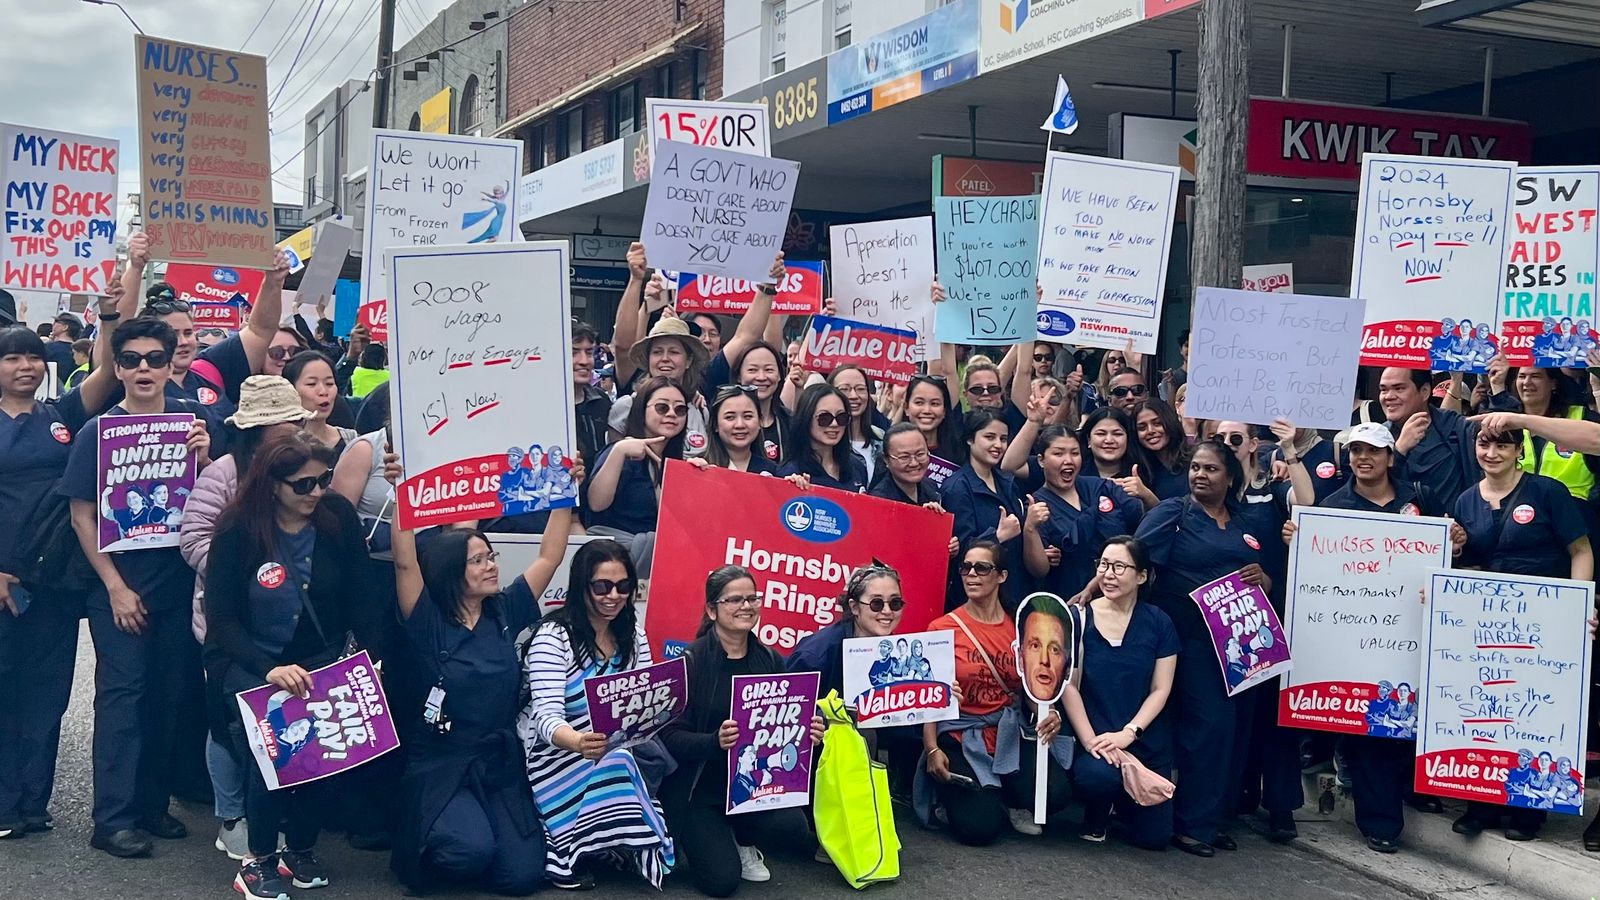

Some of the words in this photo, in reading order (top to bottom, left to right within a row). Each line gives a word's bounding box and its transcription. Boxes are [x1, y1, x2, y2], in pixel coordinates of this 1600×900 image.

[882, 26, 928, 59] WISDOM
[996, 47, 1022, 63] Selective
[1023, 37, 1045, 53] School,
[1047, 31, 1062, 45] HSC
[1063, 20, 1095, 38] Coaching
[153, 82, 191, 109] very
[774, 77, 818, 130] 8385
[153, 109, 187, 132] very
[659, 112, 718, 146] 15%
[721, 114, 756, 147] OR
[151, 132, 184, 153] very
[381, 141, 413, 165] We
[1283, 119, 1397, 163] KWIK
[13, 133, 58, 166] MY
[58, 143, 116, 175] NECK
[151, 153, 184, 177] very
[663, 152, 679, 178] A
[750, 167, 786, 191] WHO
[1380, 166, 1448, 190] 2024
[150, 178, 181, 199] very
[379, 169, 411, 192] Let
[422, 175, 436, 193] it
[442, 181, 464, 208] go
[961, 179, 991, 192] PATEL
[6, 181, 48, 210] MY
[52, 184, 113, 217] BACK
[374, 204, 406, 217] From
[717, 192, 746, 209] CARE
[751, 198, 788, 213] ABOUT
[1062, 187, 1083, 204] WE
[1088, 192, 1120, 208] HAVE
[1126, 195, 1159, 212] BEEN
[1378, 189, 1474, 215] Hornsby
[149, 200, 205, 223] CHRIS
[210, 205, 268, 228] MINNS
[409, 215, 449, 229] Frozen
[692, 206, 748, 227] NURSES
[950, 199, 989, 226] HEY
[1075, 211, 1103, 226] TOLD
[1380, 214, 1444, 231] Nurses
[1455, 208, 1493, 223] need
[5, 211, 45, 234] Fix
[47, 219, 87, 241] OUR
[88, 219, 117, 245] PAY
[167, 221, 206, 252] VERY
[390, 227, 405, 238] To
[413, 234, 437, 245] FAIR
[711, 229, 740, 245] CARE
[744, 233, 779, 249] ABOUT
[1055, 225, 1066, 235] TO
[1074, 229, 1100, 239] MAKE
[1109, 232, 1124, 241] NO
[1127, 236, 1157, 246] NOISE
[10, 236, 59, 257] THIS
[689, 243, 731, 263] YOU
[845, 228, 918, 263] Appreciation
[943, 232, 955, 252] If
[961, 237, 993, 256] you're
[1003, 238, 1028, 249] worth
[1369, 235, 1379, 244] a
[1389, 231, 1425, 253] pay
[1434, 232, 1476, 243] rise
[4, 260, 117, 293] WHACK!
[857, 258, 908, 286] doesn't
[1044, 258, 1054, 268] AS
[1060, 261, 1074, 271] WE
[1078, 263, 1100, 273] TAKE
[1105, 264, 1140, 278] ACTION
[1076, 275, 1090, 284] ON
[1576, 272, 1595, 285] IN
[411, 281, 490, 307] 2008
[949, 286, 992, 301] We're
[1000, 288, 1030, 301] worth
[1258, 274, 1290, 292] you
[852, 297, 879, 318] pay
[890, 291, 913, 310] the
[1058, 288, 1088, 301] WAGE
[1097, 289, 1158, 307] SUPPRESSION
[444, 310, 502, 342] wages
[970, 306, 1017, 336] 15%
[1200, 297, 1269, 325] Most
[1278, 303, 1350, 333] Trusted
[1080, 322, 1153, 338] nswnma.asn.au
[808, 323, 883, 359] Value
[887, 341, 916, 364] us
[1198, 328, 1288, 362] Profession
[1306, 345, 1341, 367] But
[1409, 336, 1433, 350] us
[408, 346, 434, 365] Not
[439, 347, 475, 375] good
[1191, 364, 1248, 389] Can't
[1252, 368, 1277, 392] Be
[1287, 371, 1345, 396] Trusted
[1196, 395, 1236, 413] With
[1241, 397, 1255, 413] A
[1263, 396, 1293, 418] Pay
[1299, 399, 1335, 421] Rise
[102, 423, 149, 440] STRONG
[138, 433, 160, 445] ARE
[112, 443, 188, 466] UNITED
[106, 461, 187, 486] WOMEN
[408, 475, 470, 508] Value
[473, 474, 501, 492] us
[1311, 534, 1376, 555] NURSES
[1383, 537, 1443, 555] DESERVE
[725, 537, 860, 591] Hornsby
[1342, 556, 1392, 576] MORE!
[1203, 580, 1235, 607] GIRLS
[1299, 584, 1329, 595] MORE
[1332, 586, 1356, 597] Than
[1359, 585, 1404, 598] Thanks!
[1443, 579, 1524, 598] NURSES
[1537, 586, 1561, 599] AT
[1218, 595, 1258, 626] FAIR
[1307, 613, 1324, 624] WE
[1332, 610, 1378, 625] SHOULD
[1382, 614, 1401, 626] BE
[1434, 611, 1466, 627] The
[1478, 617, 1520, 632] work
[1231, 609, 1270, 641] PAY!
[1360, 637, 1418, 652] VALUED
[1474, 630, 1543, 649] HARDER
[1434, 649, 1463, 662] The
[1469, 651, 1510, 665] shifts
[1515, 656, 1535, 666] are
[1537, 655, 1578, 674] longer
[596, 672, 651, 697] GIRLS
[1479, 667, 1513, 682] BUT
[611, 686, 671, 719] FAIR
[741, 679, 790, 702] GIRLS
[858, 686, 915, 716] Value
[919, 685, 943, 703] us
[1288, 689, 1341, 712] Value
[1344, 697, 1370, 713] us
[1436, 685, 1462, 701] The
[1505, 688, 1522, 702] is
[1525, 688, 1556, 705] the
[748, 703, 802, 730] FAIR
[753, 725, 806, 750] PAY!
[1435, 722, 1454, 737] Fix
[1472, 727, 1497, 740] now
[1425, 755, 1480, 780] Value
[1483, 765, 1509, 782] us
